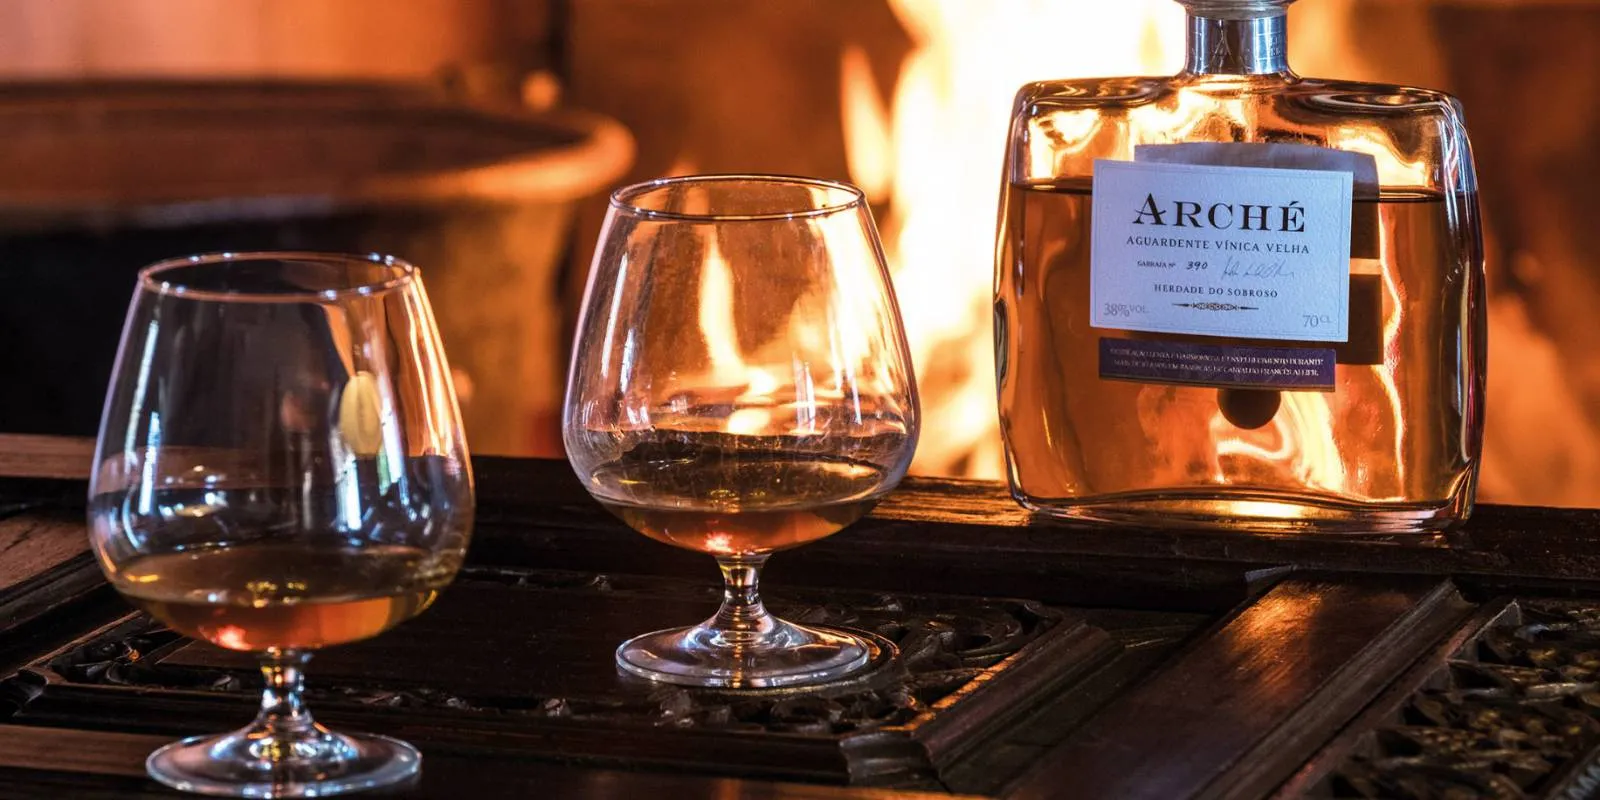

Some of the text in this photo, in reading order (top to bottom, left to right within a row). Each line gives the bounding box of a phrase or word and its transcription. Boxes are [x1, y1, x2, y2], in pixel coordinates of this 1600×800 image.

[1132, 192, 1305, 232] ARCHÉ
[1126, 235, 1310, 254] AGUARDENTE VÍNICA VELHA
[1186, 261, 1208, 271] 390
[1154, 284, 1278, 298] HERDADE DO SOBROSO
